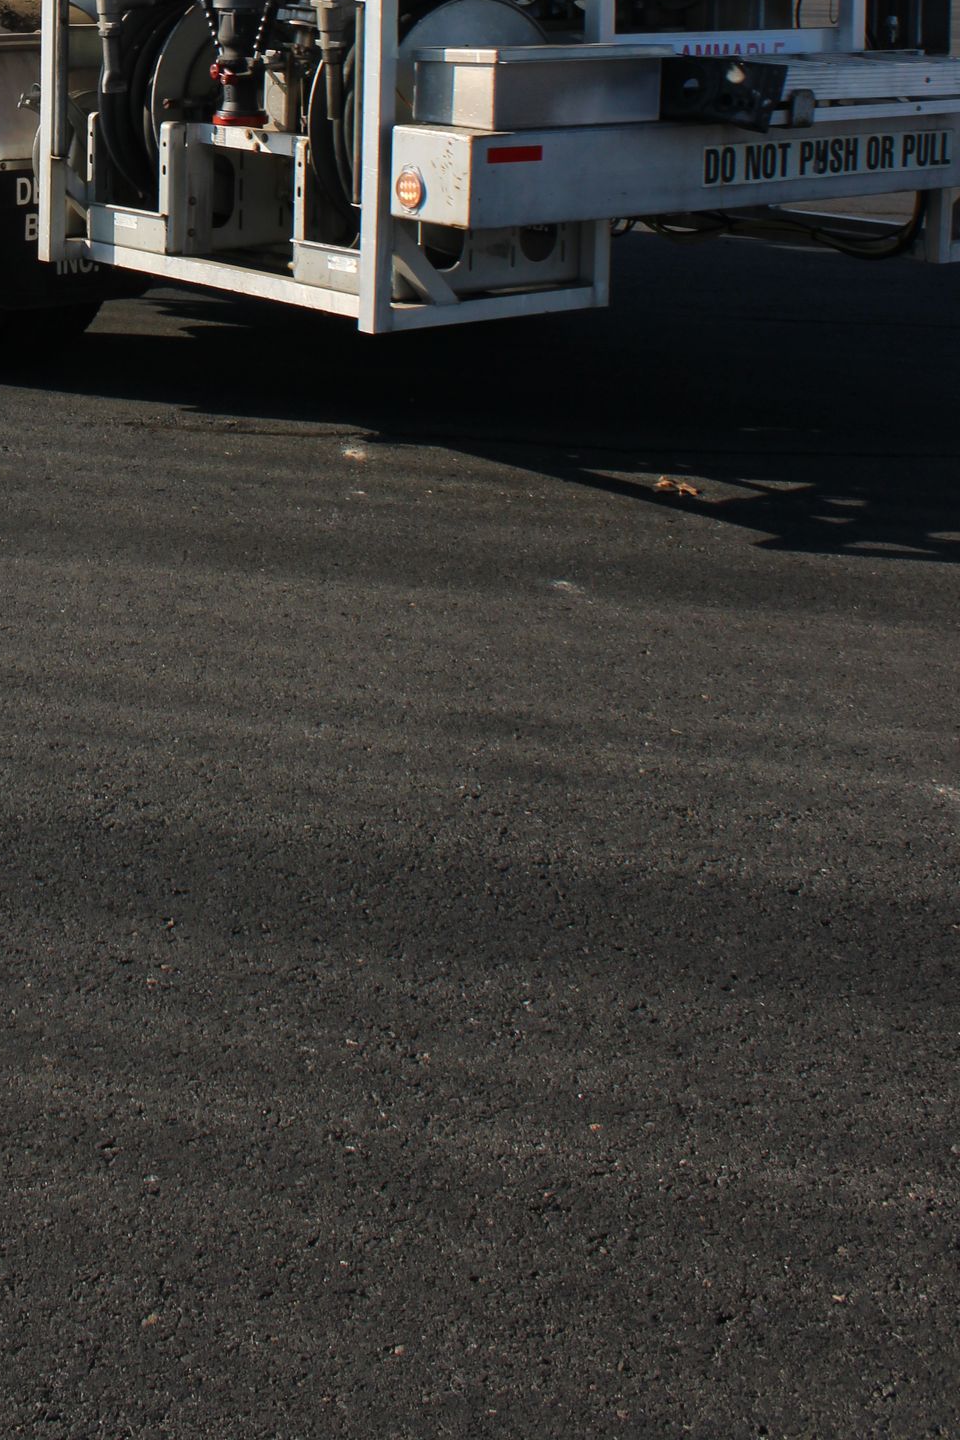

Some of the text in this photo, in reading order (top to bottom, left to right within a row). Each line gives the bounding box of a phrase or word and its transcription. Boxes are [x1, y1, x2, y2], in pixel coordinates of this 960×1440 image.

[704, 132, 952, 184] DO NOT PUSH OR PULL
